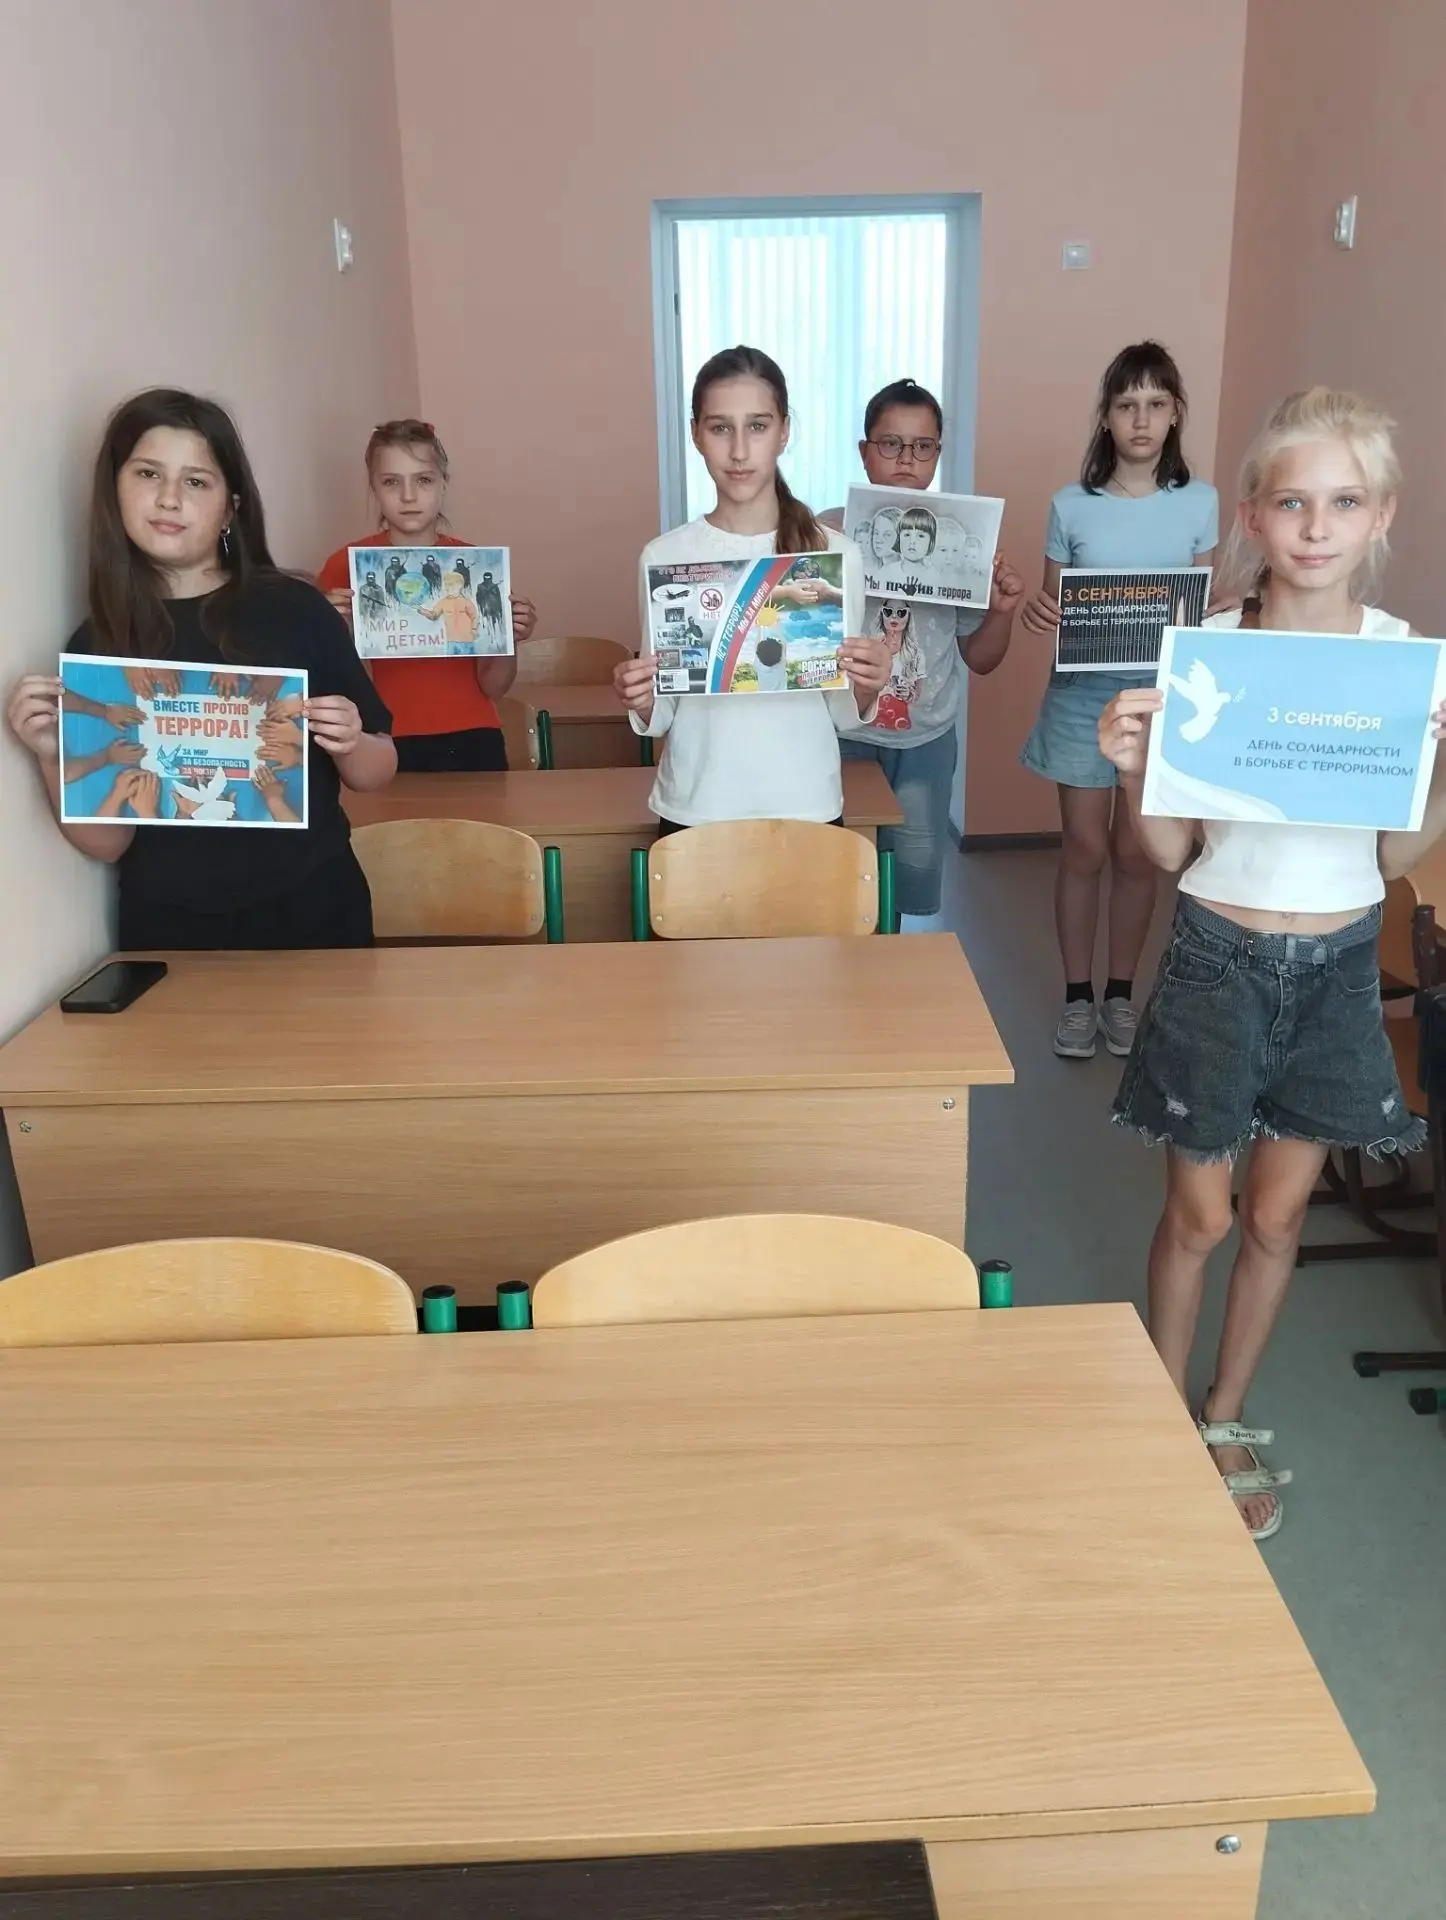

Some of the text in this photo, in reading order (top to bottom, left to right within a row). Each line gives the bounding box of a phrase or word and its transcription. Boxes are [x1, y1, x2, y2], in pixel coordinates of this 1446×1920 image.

[864, 575, 972, 600] Мы проив террора
[1064, 585, 1169, 601] 3 СЕНТЯБРЯ
[1064, 604, 1168, 616] ДЕНЬ СОЛИДАРНОСТИ
[369, 619, 409, 632] МИР
[1070, 618, 1100, 626] БОРЬБЕ
[1110, 616, 1168, 625] ТЕРРОРИЗМОМ
[386, 628, 445, 651] ДЕТЯМ!
[802, 660, 836, 672] РОССИЯ
[153, 699, 249, 716] ВМЕСТЕ ПРОТИВ
[154, 715, 249, 739] ТЕРРОРА!
[1267, 706, 1383, 732] 3 сентября
[1246, 739, 1401, 758] ДЕНЬ СОЛИДАРНОСТИ
[194, 758, 247, 768] БЕЗОПАСНОСТЬ
[1234, 756, 1414, 777] В БОРЬБЕ С ТЕРРОРИЗМОМ
[1228, 1430, 1256, 1439] Sports
